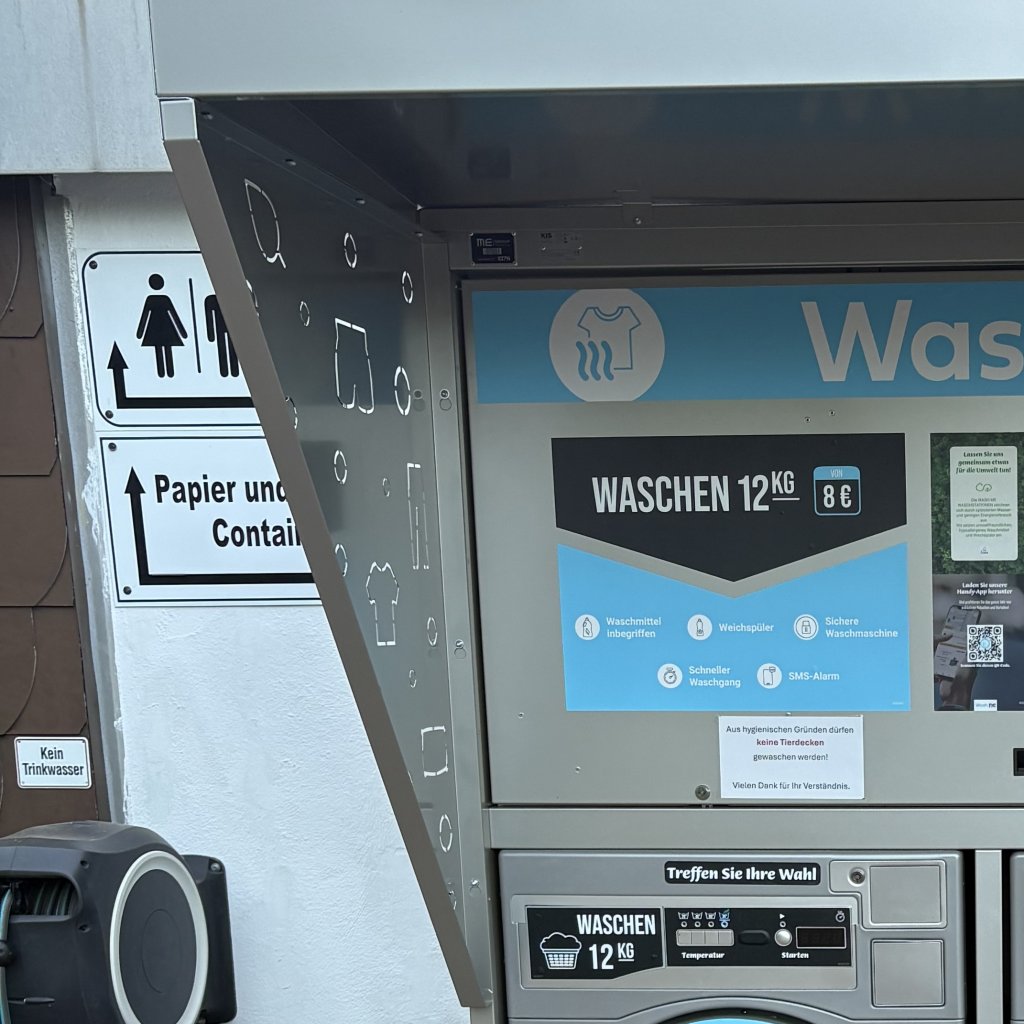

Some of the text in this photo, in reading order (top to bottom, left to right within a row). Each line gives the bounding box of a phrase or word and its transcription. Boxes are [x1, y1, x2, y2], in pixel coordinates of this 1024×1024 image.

[830, 469, 843, 478] VON
[154, 473, 236, 510] Papier
[592, 475, 729, 513] WASCHEN
[823, 485, 852, 508] 8 €
[212, 518, 301, 547] Contai
[606, 617, 661, 626] Waschmittel
[825, 617, 859, 626] Sichere
[719, 622, 774, 633] Weichspüler
[825, 628, 898, 638] Waschmaschine
[607, 629, 655, 639] inbegriffen
[689, 666, 730, 675] Schneller
[789, 671, 840, 681] SMS-Alarm
[689, 677, 741, 688] Waschgang
[742, 726, 792, 734] hygienischen
[41, 747, 63, 759] Kein
[22, 763, 84, 775] Trinkwasser
[803, 782, 850, 790] Verständnis.
[667, 866, 816, 882] Treffen Sie Ihre Wahl
[577, 914, 656, 936] WASCHEN
[588, 943, 634, 970] 12 KG
[681, 952, 725, 960] Temperatur
